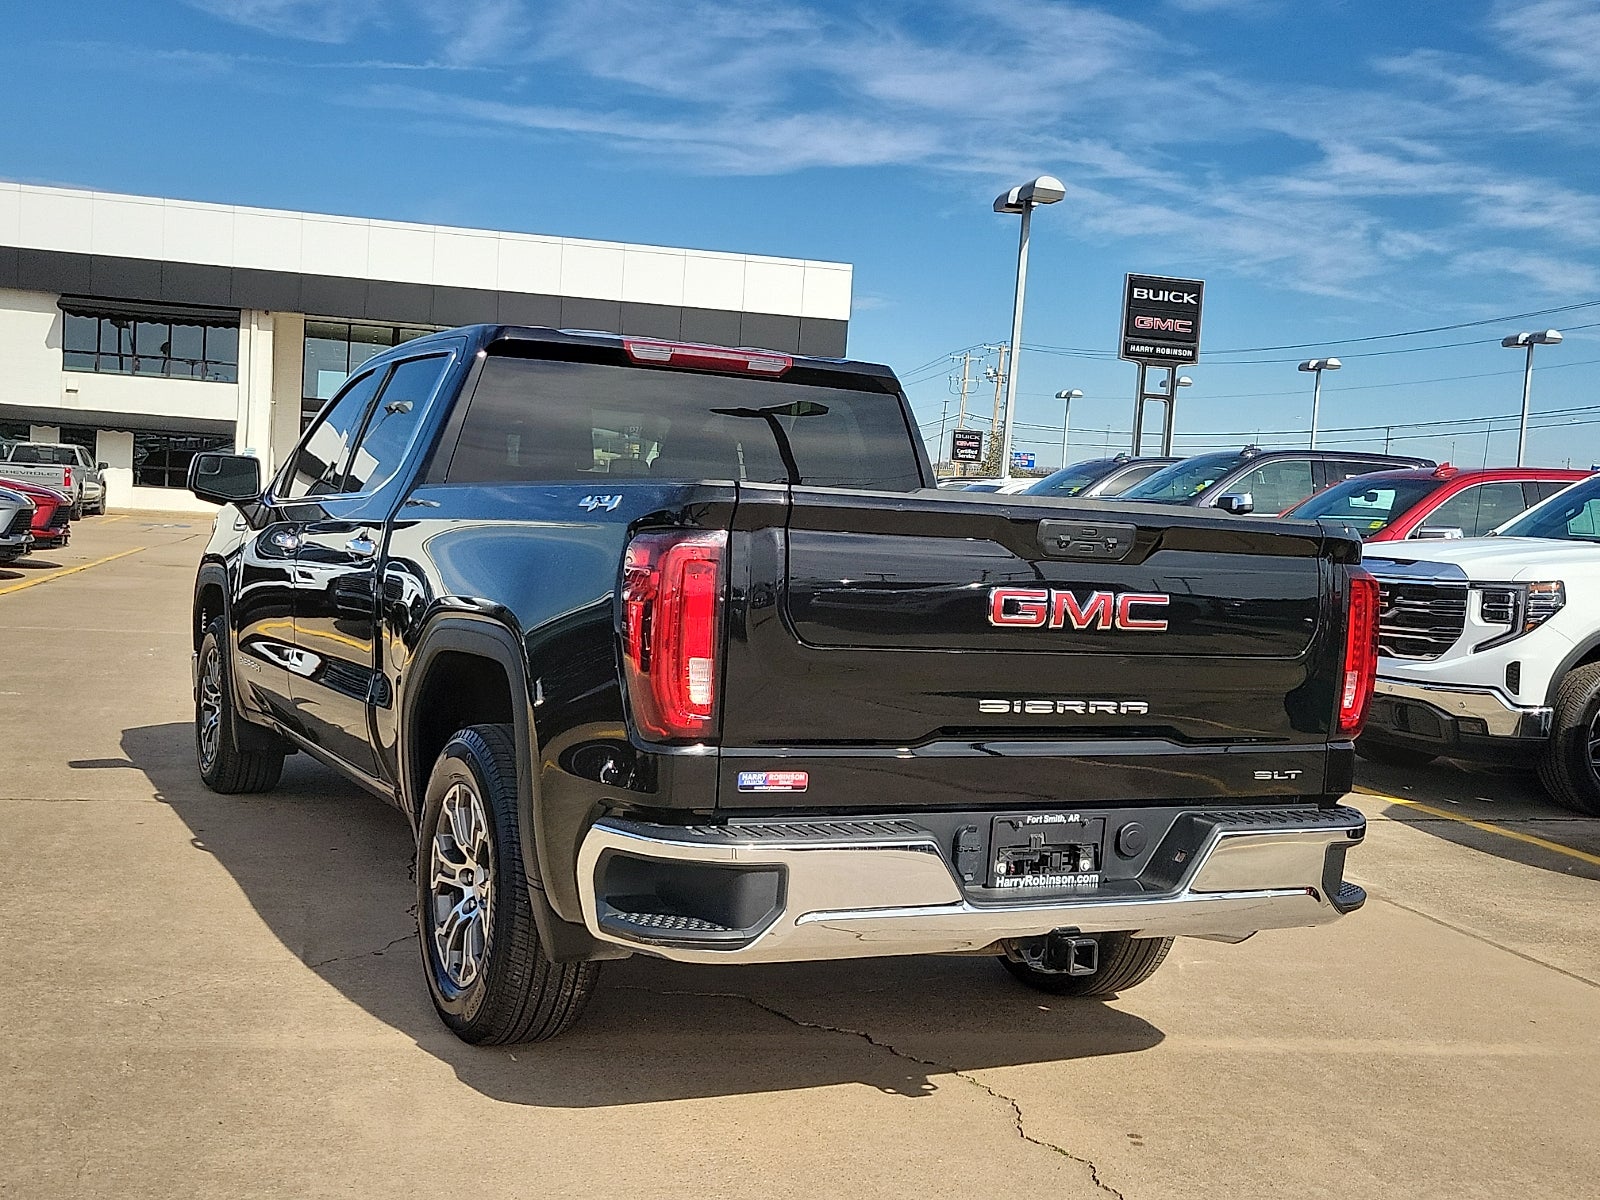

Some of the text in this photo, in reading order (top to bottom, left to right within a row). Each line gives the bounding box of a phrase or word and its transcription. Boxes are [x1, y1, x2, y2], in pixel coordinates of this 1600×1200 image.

[1133, 287, 1199, 304] BUICK
[1134, 315, 1193, 333] GMC
[1130, 344, 1193, 357] HARRY ROBINSON
[956, 440, 980, 448] GMC
[987, 586, 1170, 632] GMC
[978, 699, 1149, 715] SIERRA
[1254, 769, 1303, 780] SLT
[1026, 814, 1080, 824] Fort Smith, AR
[995, 874, 1099, 888] HarryRobinson.com
